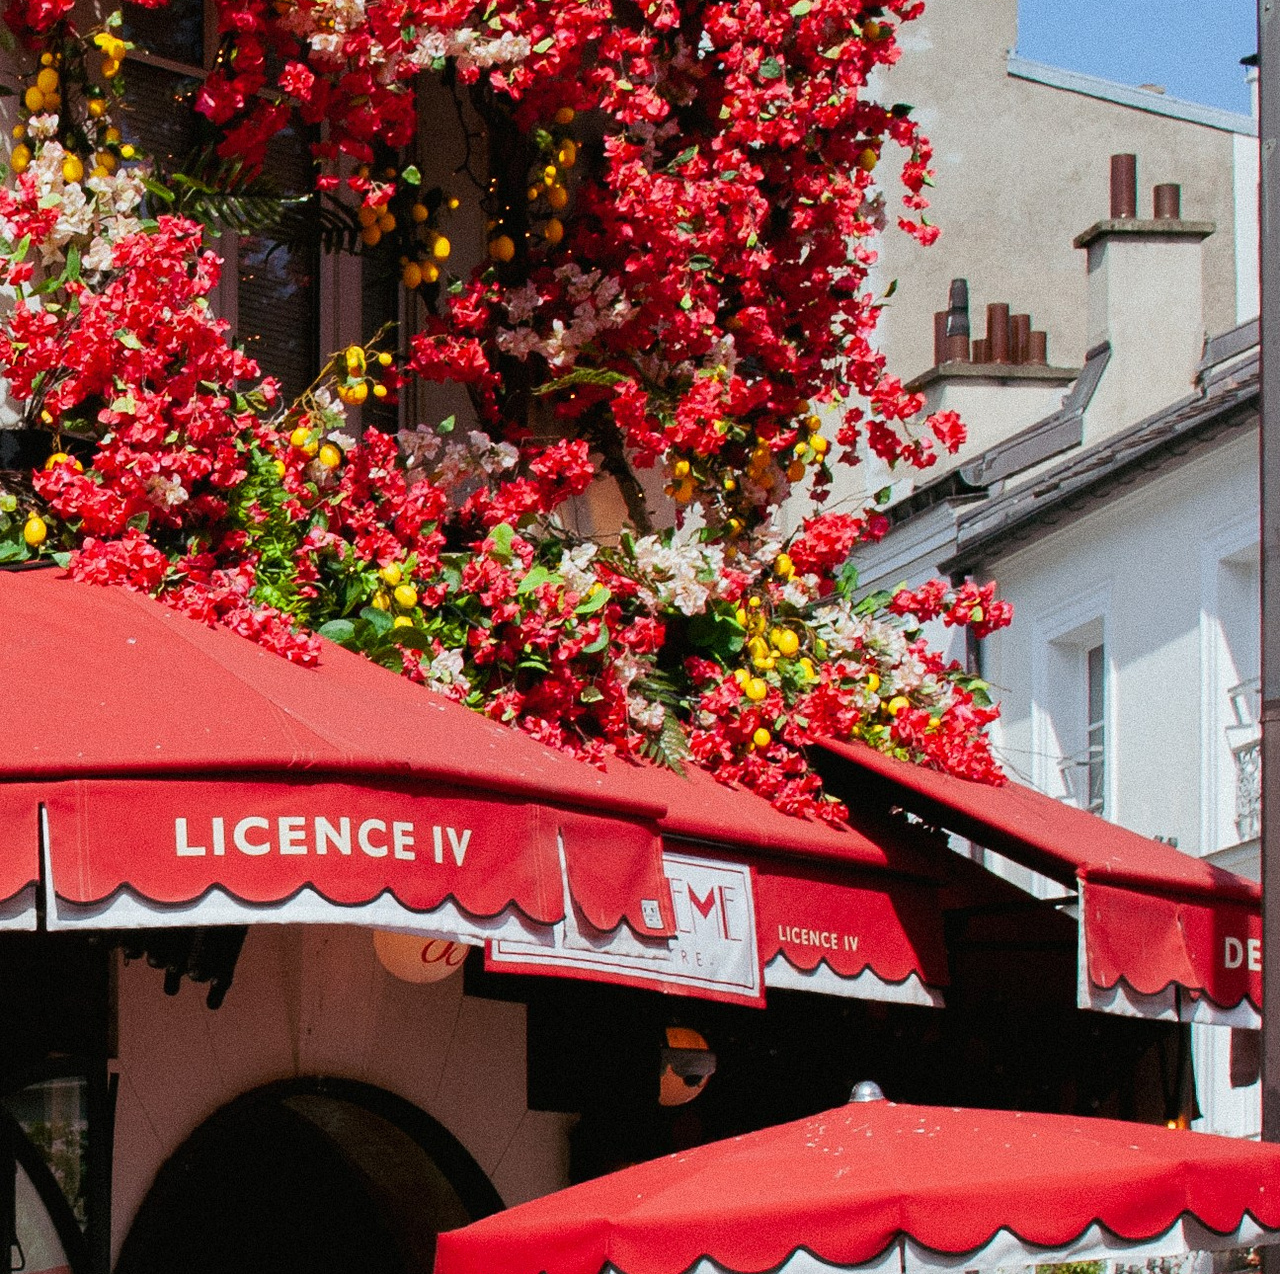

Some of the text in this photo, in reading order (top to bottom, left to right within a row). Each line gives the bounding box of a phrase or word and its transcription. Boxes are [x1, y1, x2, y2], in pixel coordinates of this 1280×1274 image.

[175, 816, 472, 866] LICENCE IV
[778, 925, 859, 952] LICENCE IV
